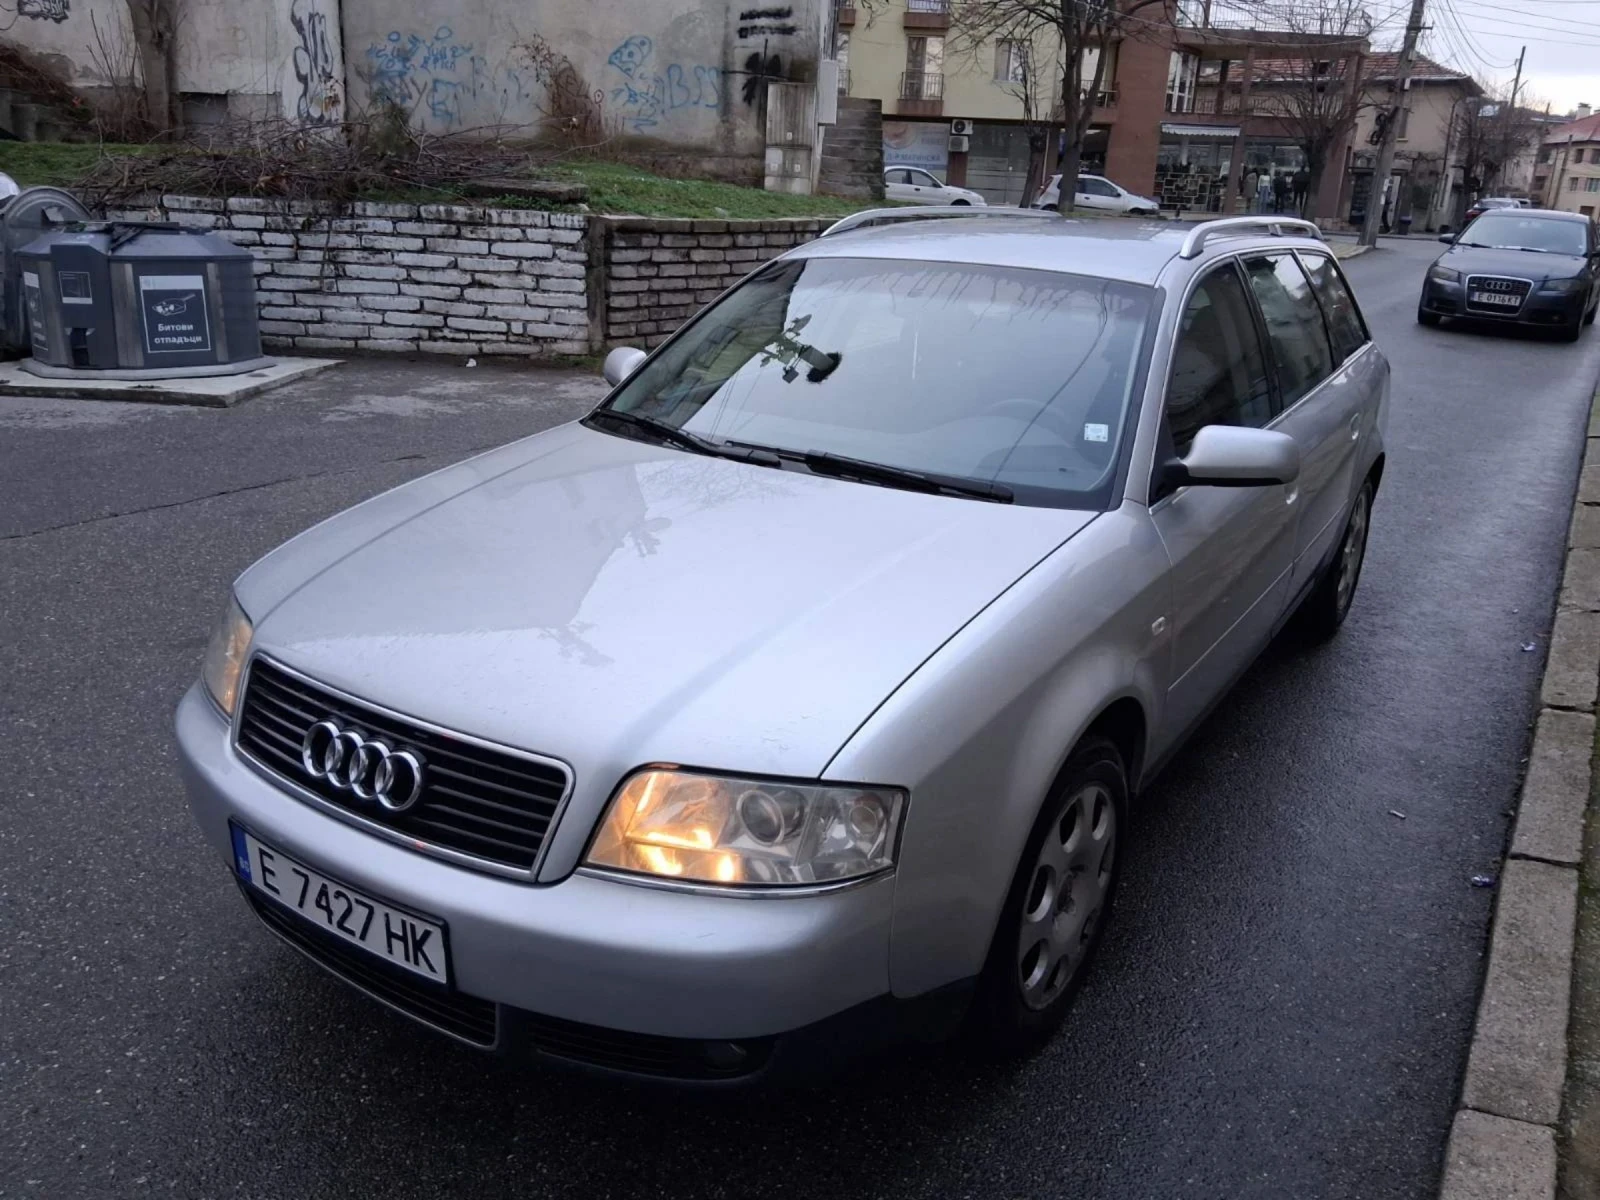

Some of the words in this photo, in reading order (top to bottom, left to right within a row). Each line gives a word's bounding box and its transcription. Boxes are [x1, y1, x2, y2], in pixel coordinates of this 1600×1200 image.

[158, 323, 194, 332] Битови
[154, 336, 202, 344] отпадъци
[258, 847, 280, 895] E
[292, 867, 375, 942] 7427
[384, 912, 438, 974] HK
